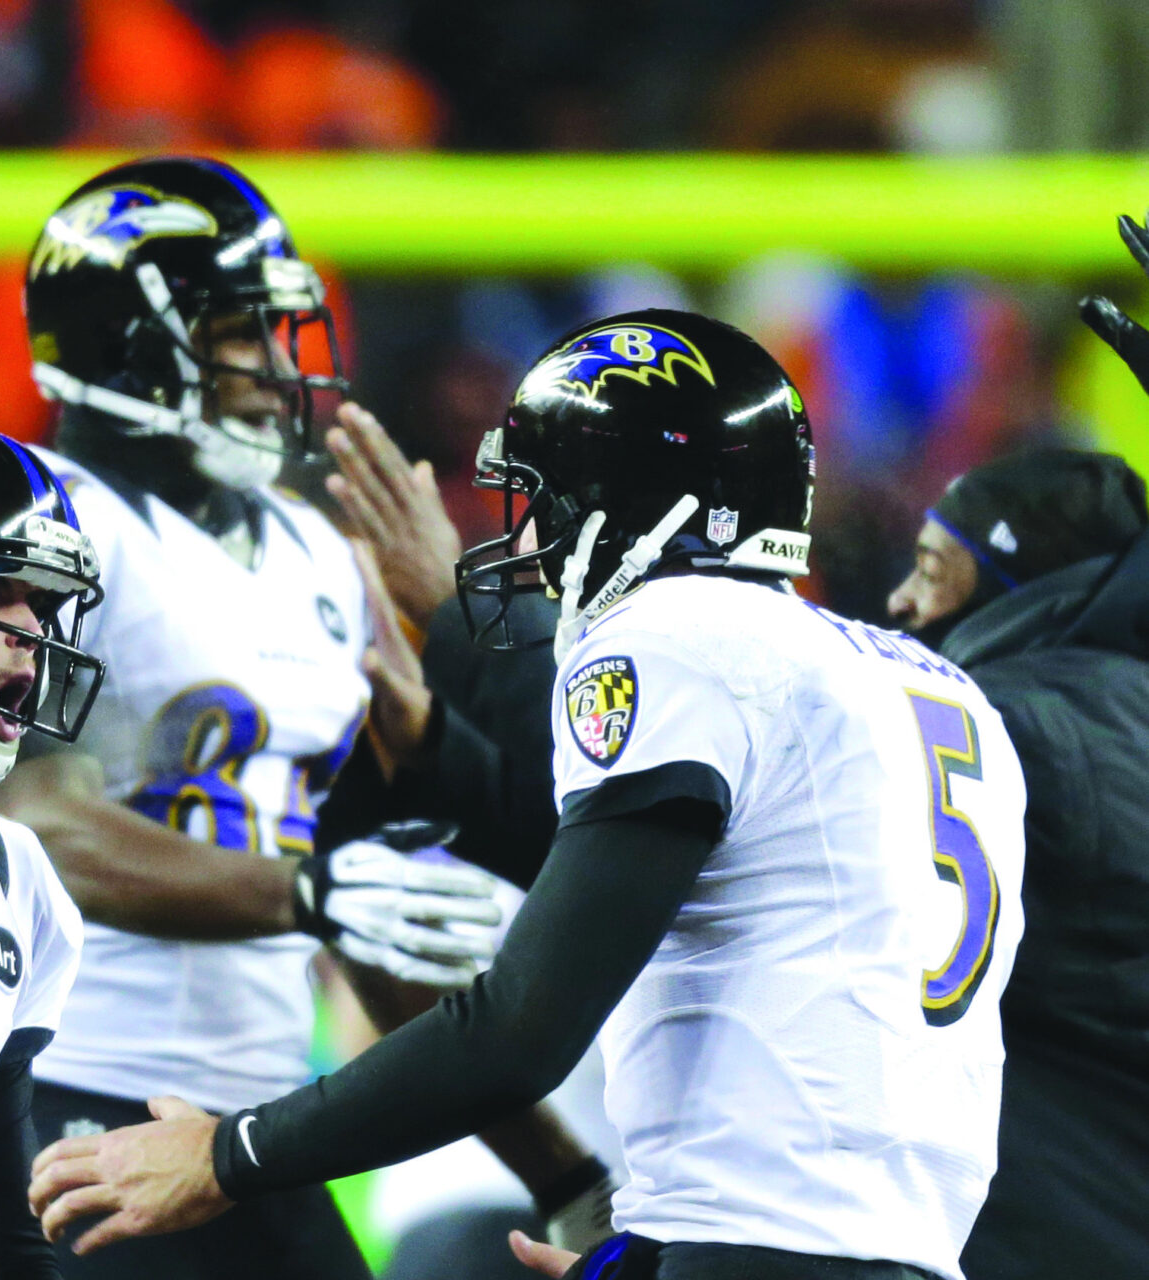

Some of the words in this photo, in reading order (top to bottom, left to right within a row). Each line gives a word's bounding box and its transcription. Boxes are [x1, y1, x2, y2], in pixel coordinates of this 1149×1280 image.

[712, 522, 734, 539] NFL
[567, 660, 627, 692] RAVENS
[577, 681, 598, 721] B
[600, 707, 630, 744] R
[903, 686, 1002, 1028] 5
